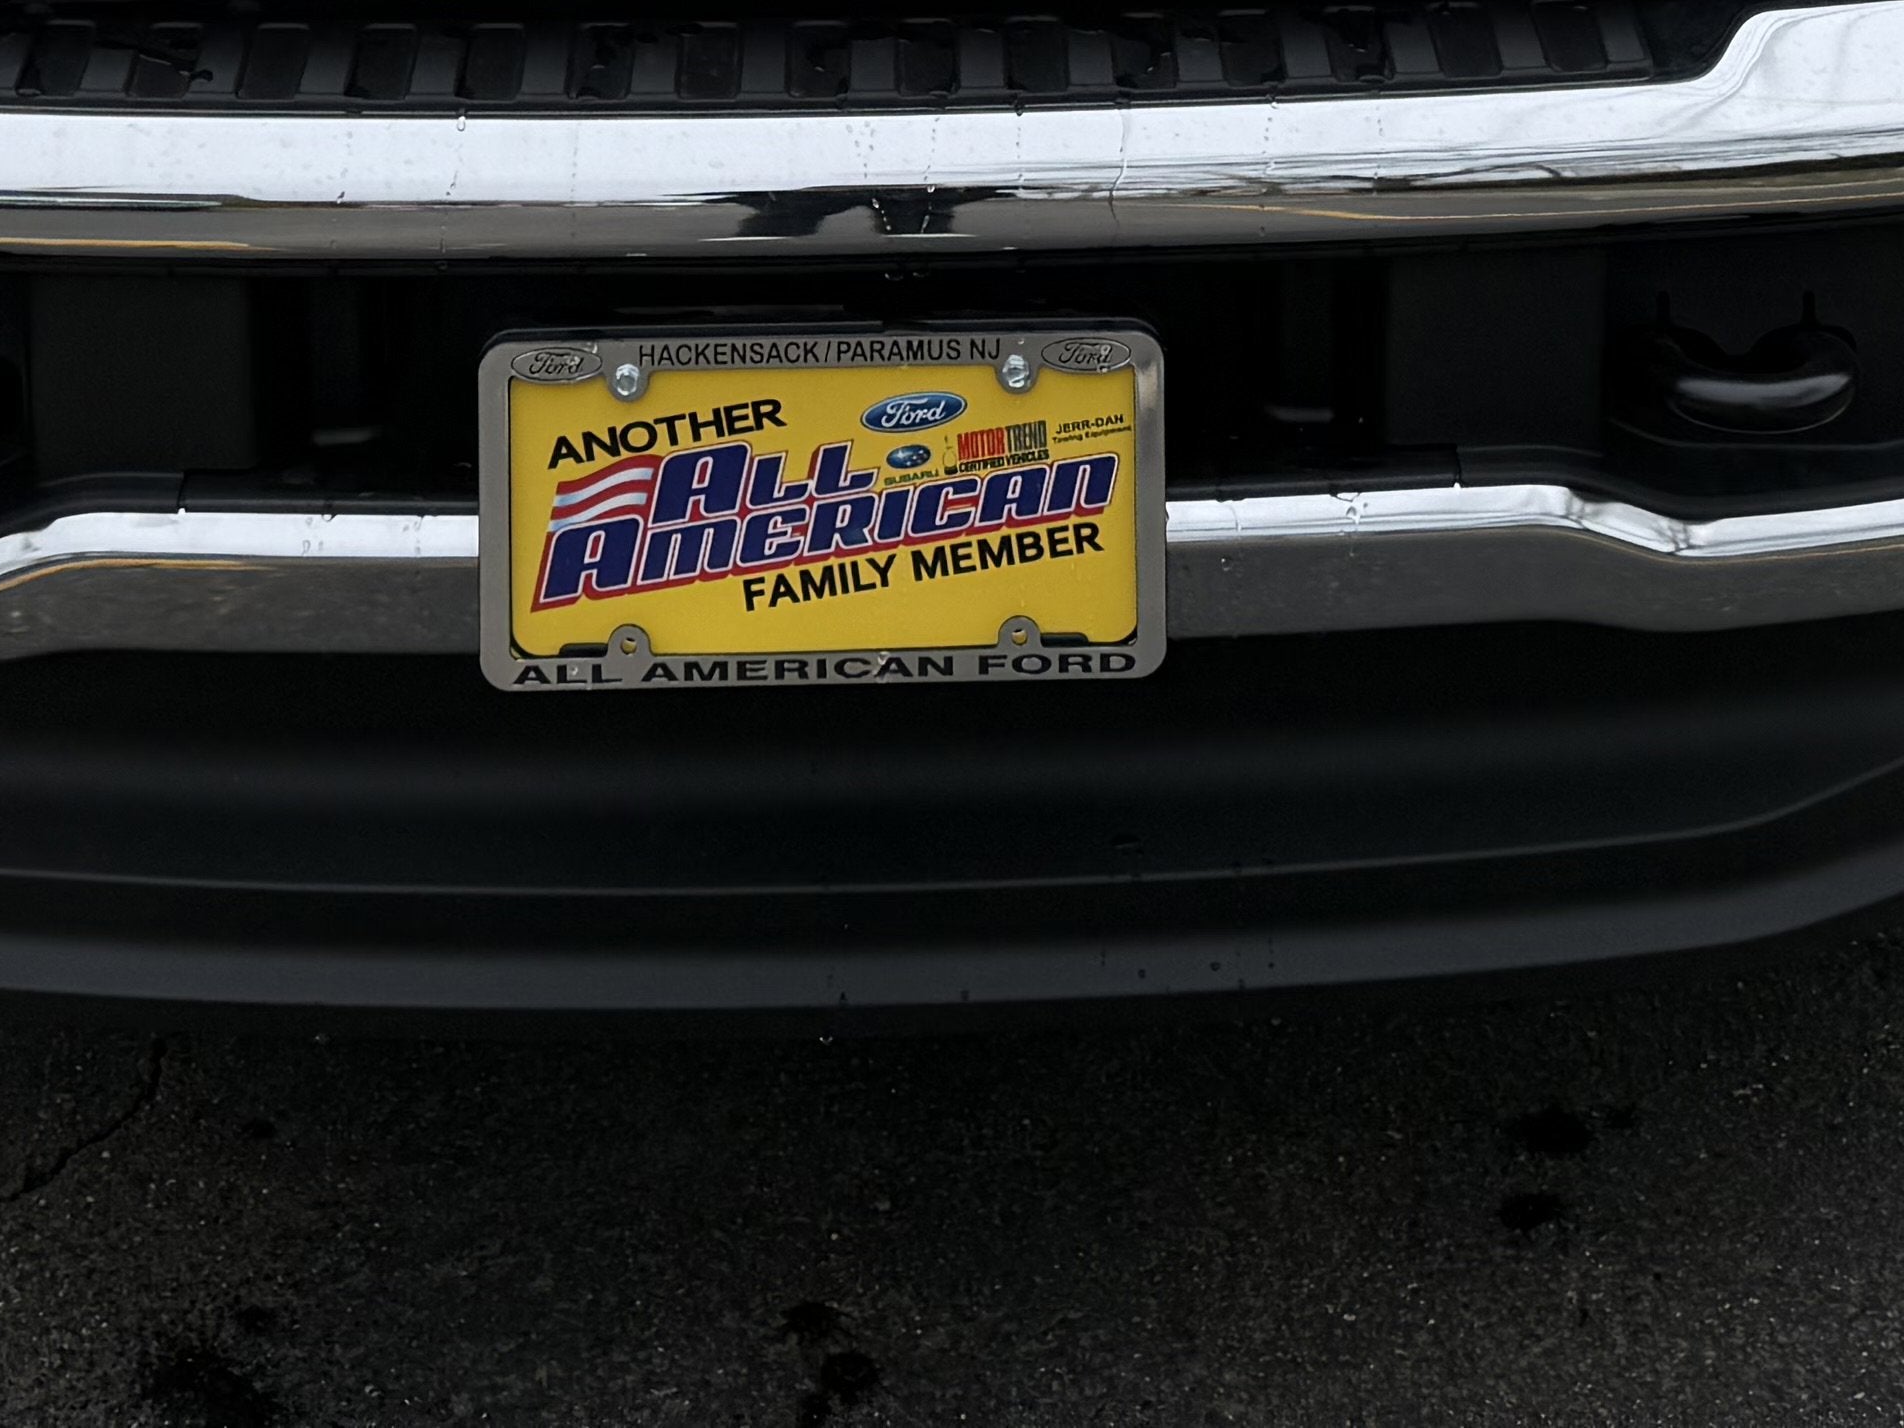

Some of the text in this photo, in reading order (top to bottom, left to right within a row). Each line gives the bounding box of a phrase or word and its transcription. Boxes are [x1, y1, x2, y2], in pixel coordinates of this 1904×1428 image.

[529, 351, 584, 375] Ford
[969, 338, 1001, 360] NJ
[1059, 342, 1113, 364] Ford
[881, 397, 946, 429] Ford
[547, 399, 789, 470] ANOTHER
[646, 440, 882, 529] ALL
[884, 470, 939, 486] SUBARU
[532, 452, 1122, 612] AMERICAN
[742, 522, 1105, 612] FAMILY MEMBER
[513, 652, 1138, 685] ALL AMERICAN FORD
